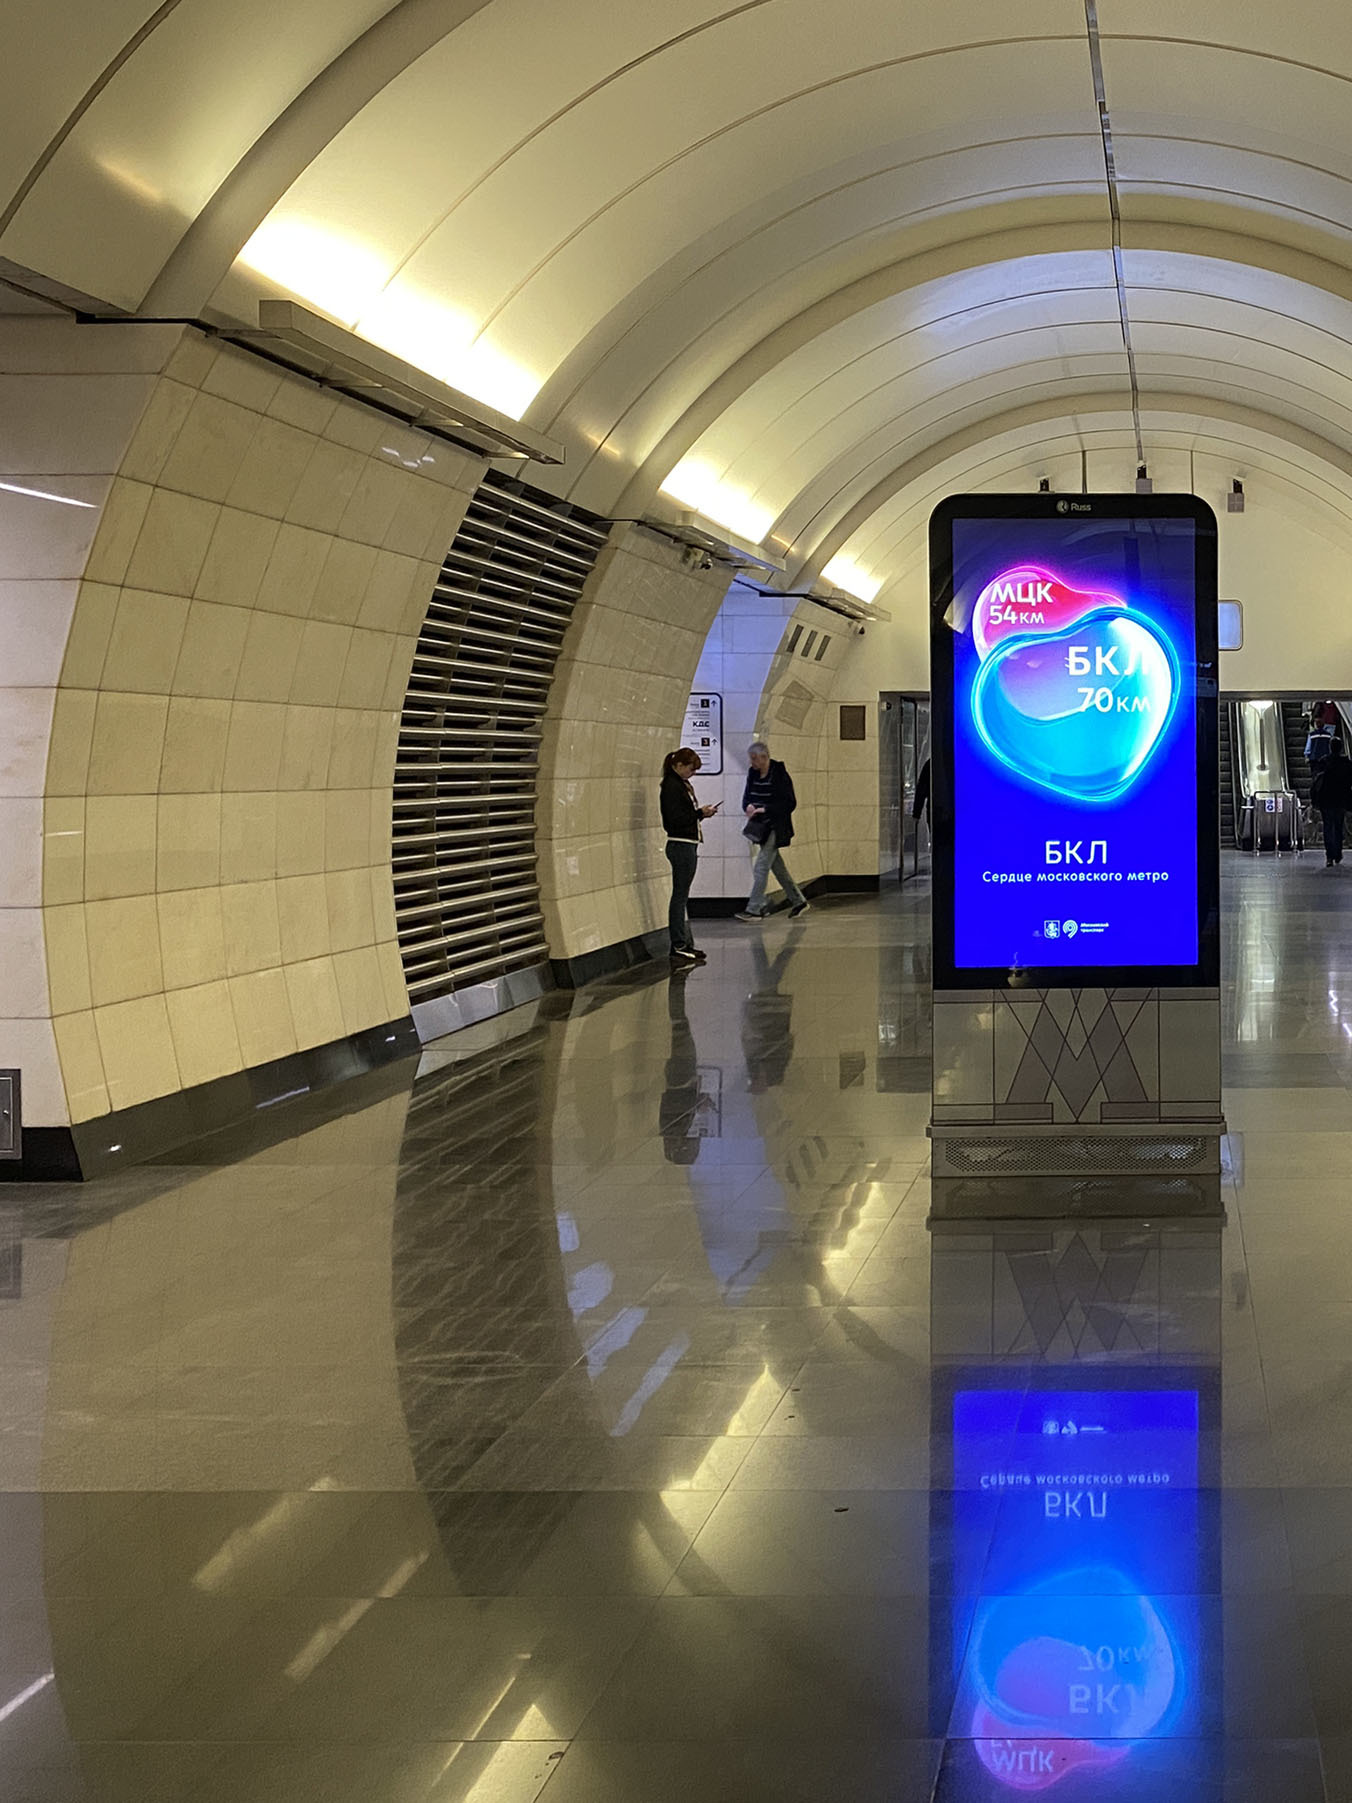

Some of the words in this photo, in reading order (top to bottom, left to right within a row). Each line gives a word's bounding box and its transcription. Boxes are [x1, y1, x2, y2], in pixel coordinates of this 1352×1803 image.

[1070, 502, 1092, 511] Russ
[989, 582, 1053, 606] МЦК
[1067, 646, 1149, 676] БКЛ
[1045, 841, 1107, 864] БКЛ
[982, 871, 1033, 884] Сердце
[1036, 872, 1123, 882] московского
[1127, 871, 1170, 883] метро
